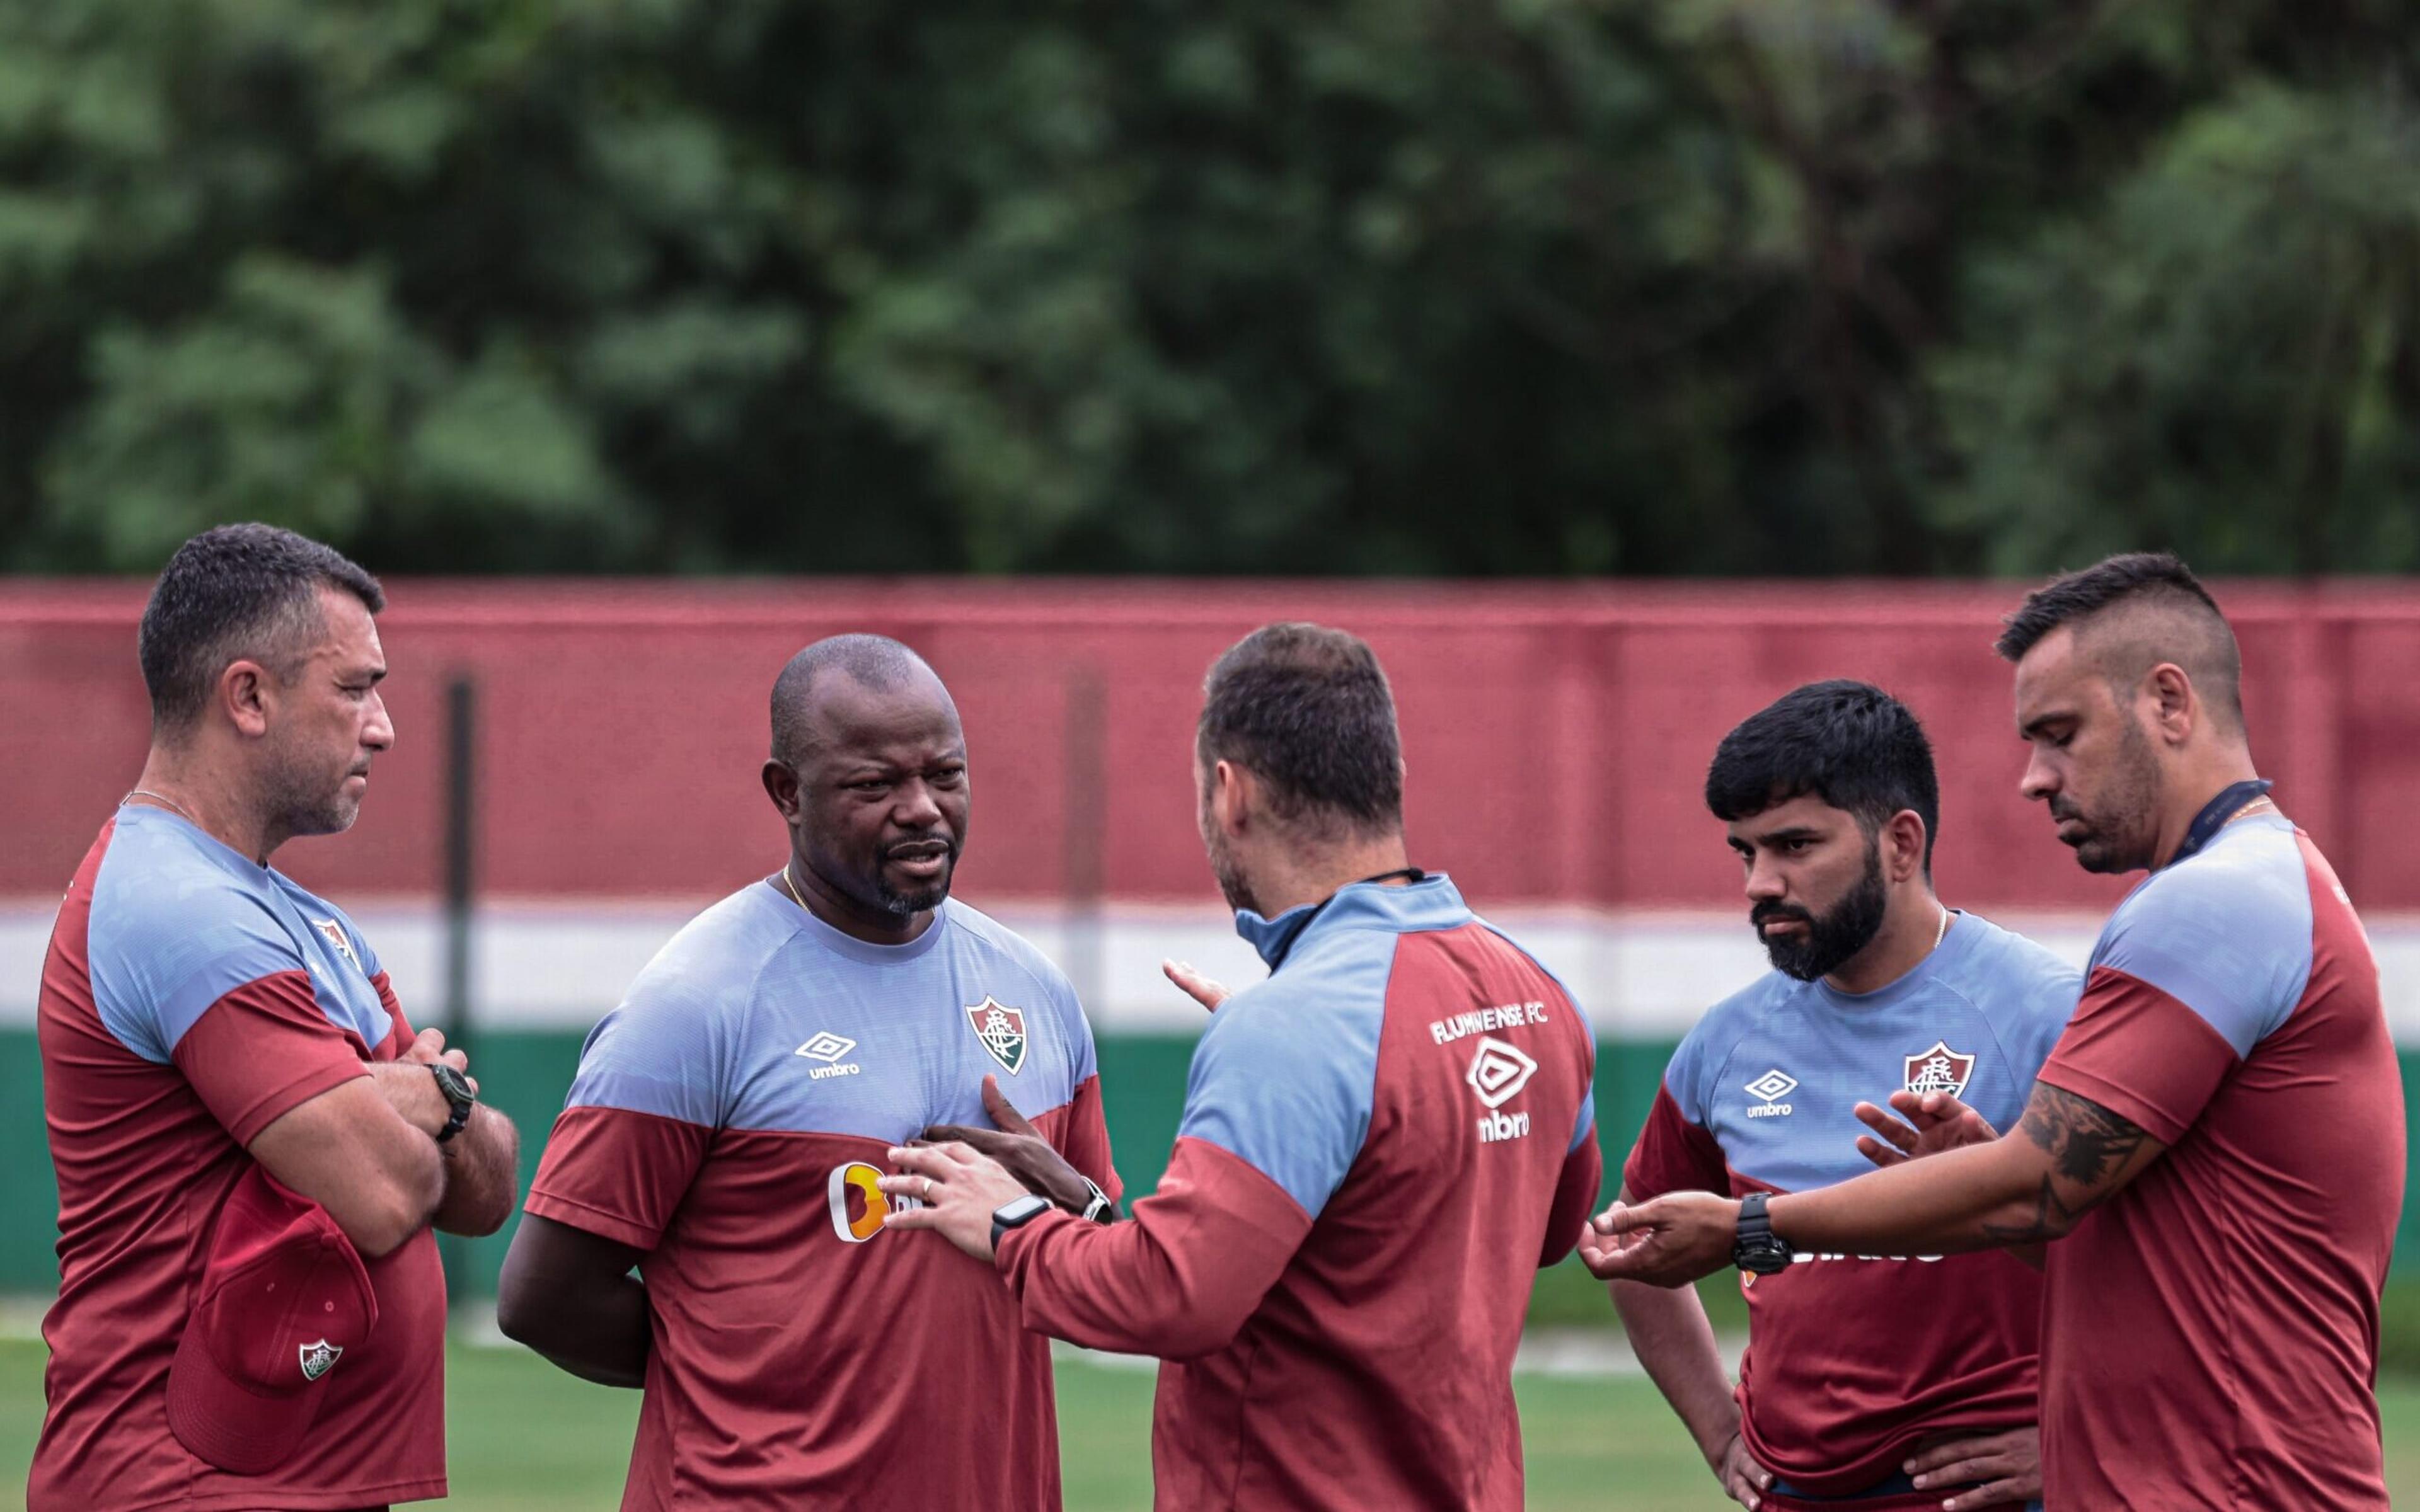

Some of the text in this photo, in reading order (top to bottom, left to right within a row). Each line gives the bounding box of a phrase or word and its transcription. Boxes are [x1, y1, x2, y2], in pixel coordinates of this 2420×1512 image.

[1430, 1001, 1548, 1045] FLUMNENSE FC
[809, 1063, 860, 1079] umbro
[1747, 1102, 1792, 1118] umbro
[1476, 1109, 1530, 1142] mbro
